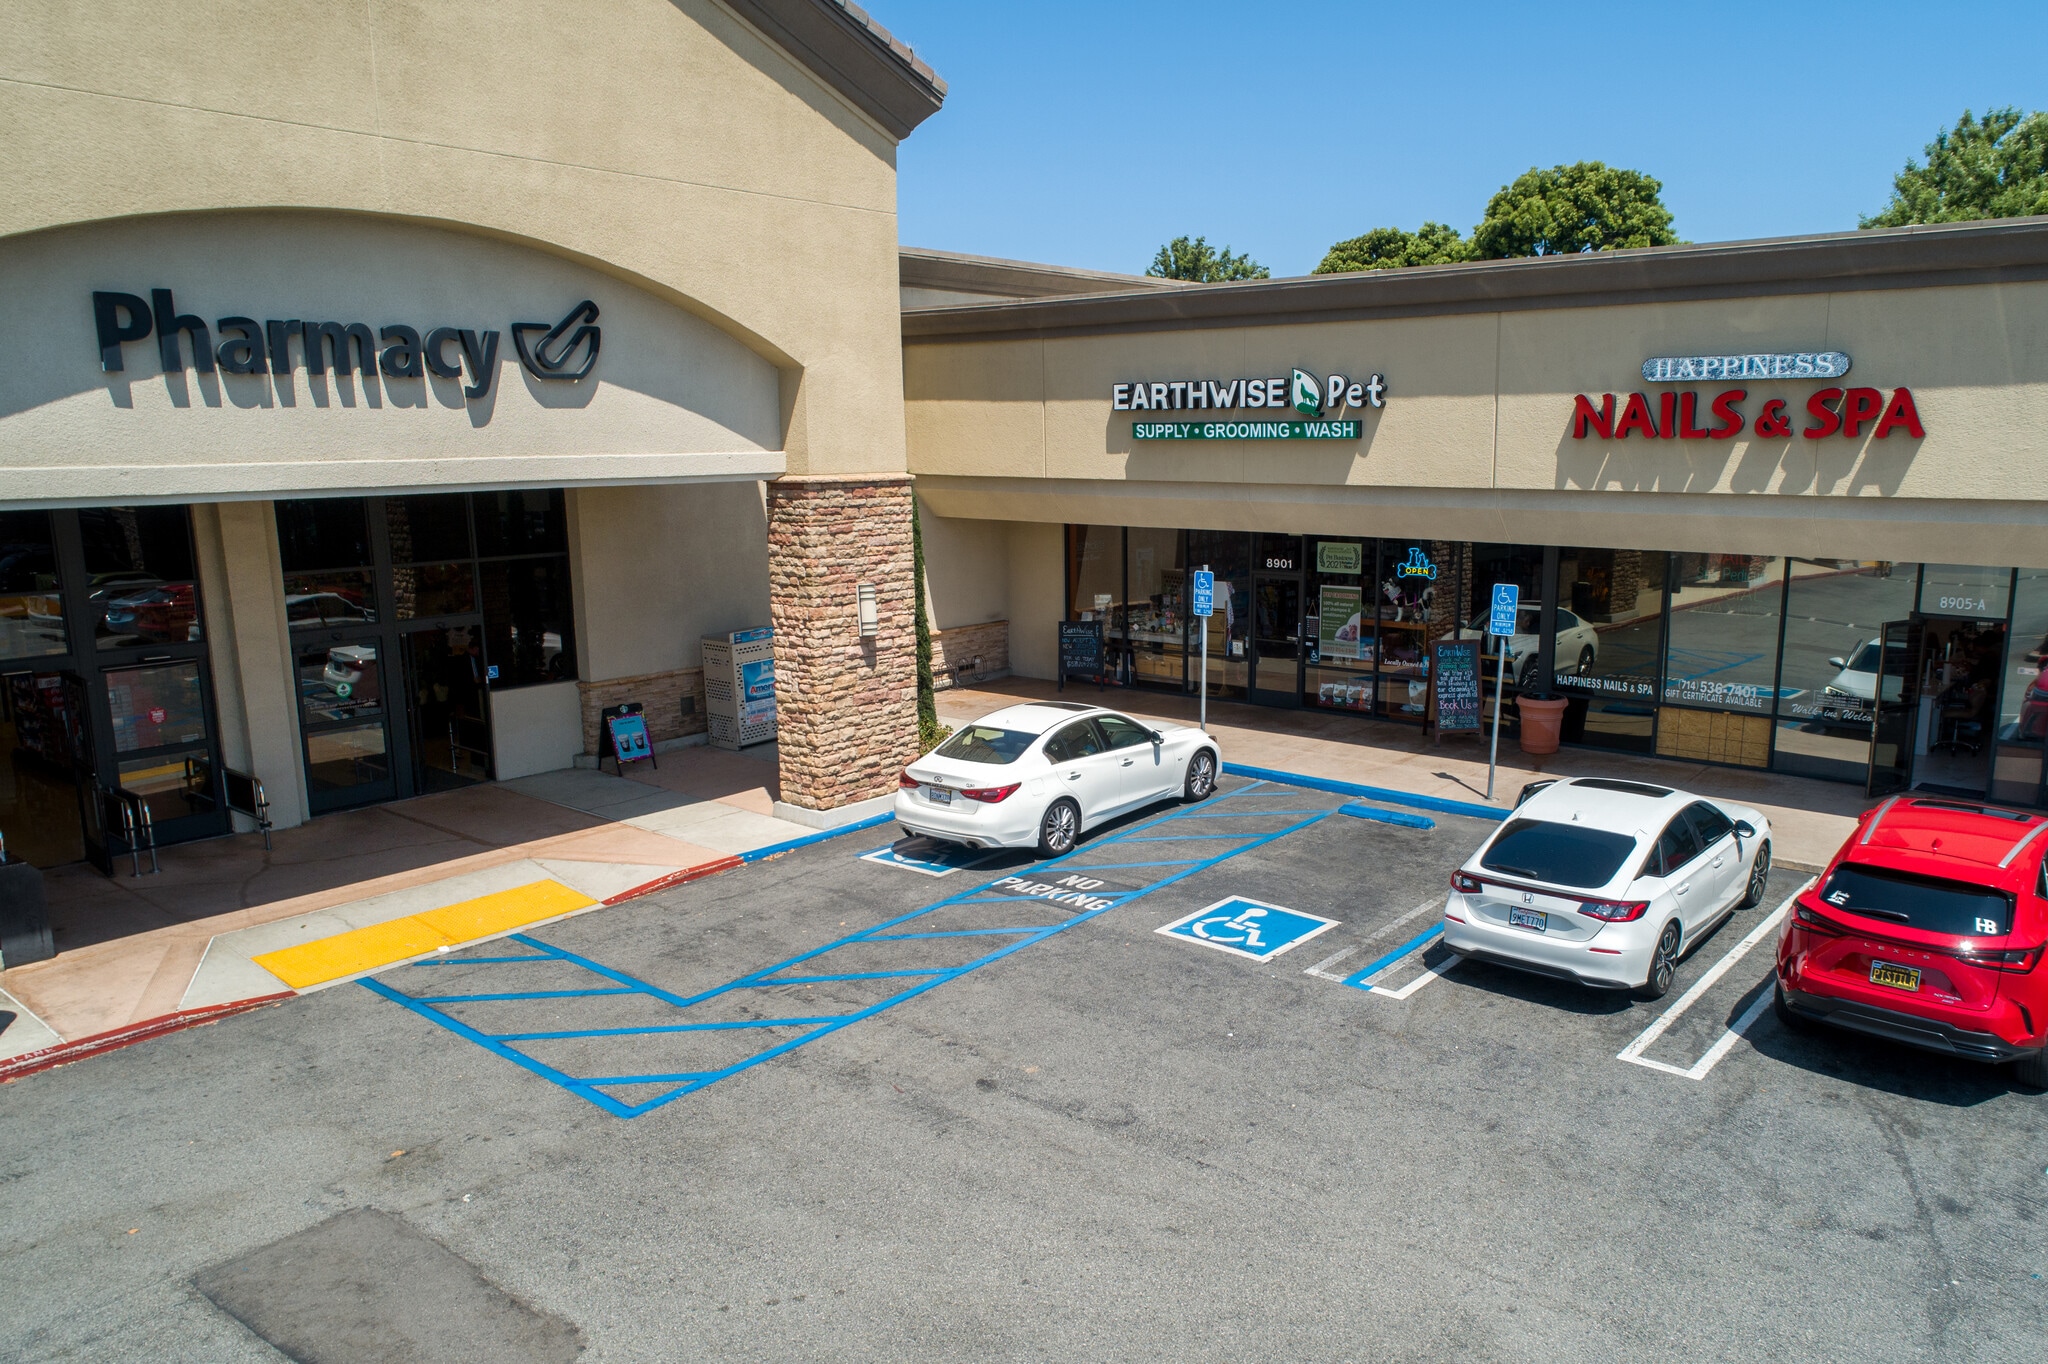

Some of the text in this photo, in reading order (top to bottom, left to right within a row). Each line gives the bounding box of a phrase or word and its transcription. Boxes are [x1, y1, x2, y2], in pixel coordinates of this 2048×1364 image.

[93, 288, 499, 398] Pharmacy
[1655, 354, 1836, 378] HAPPINESS
[1112, 373, 1387, 411] EARTHWISE Pet
[1573, 386, 1926, 440] NAILS & SPA
[1135, 421, 1354, 438] SUPPLY GROOMING WASH
[1266, 558, 1292, 569] 8901
[1405, 567, 1429, 575] OPEN
[1723, 567, 1770, 585] Pedicur
[1493, 604, 1515, 613] PARKING
[1939, 596, 1986, 611] 8905-A
[1496, 612, 1511, 621] ONLY
[1384, 658, 1401, 668] Locally
[750, 682, 776, 695] Ameri
[1556, 674, 1653, 696] HAPPINESS NAILS & SPA
[1678, 679, 1757, 699] (714) 536-7401
[1439, 699, 1472, 710] Book Us
[1665, 688, 1763, 708] GIFT CERTIFICATE AVAILABLE
[1842, 709, 1873, 722] Welco
[1056, 874, 1105, 890] NO
[991, 876, 1114, 911] PARKING
[1975, 917, 1997, 934] HB
[1863, 942, 1930, 960] LEXUS
[11, 1048, 56, 1063] LANE
